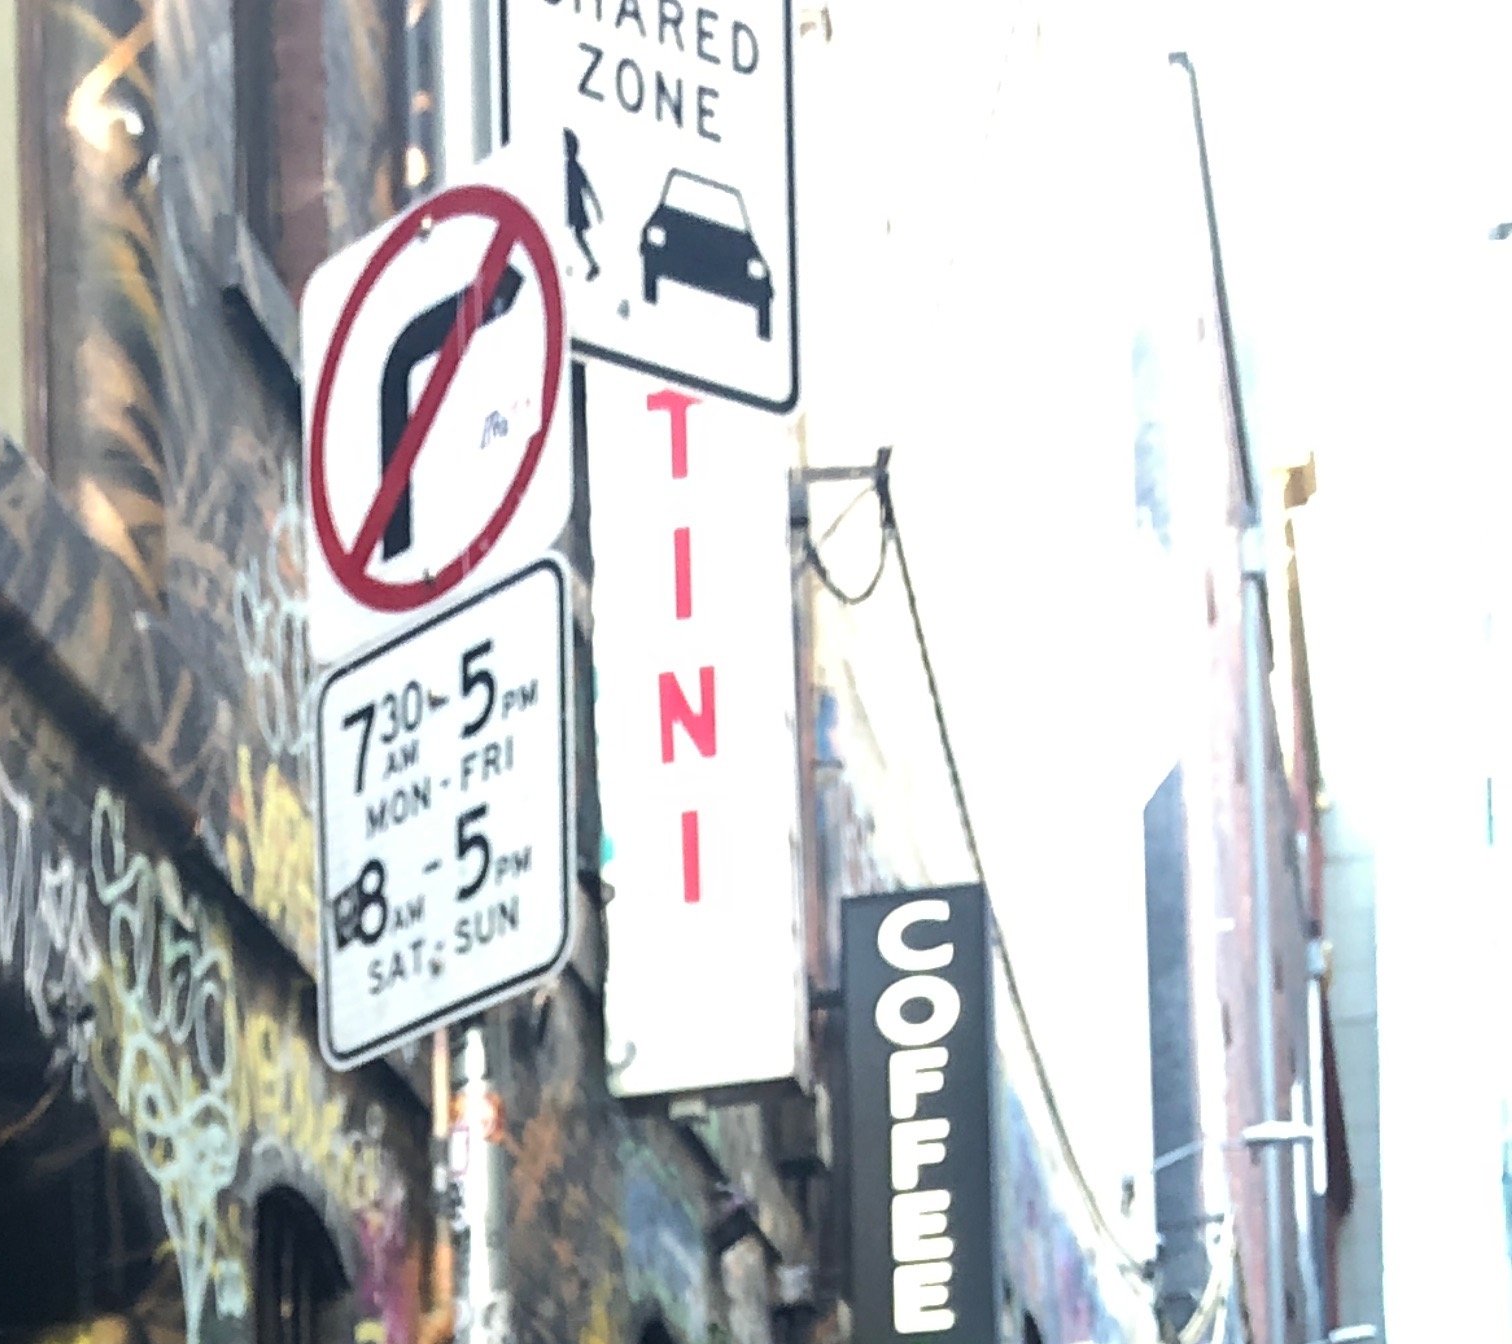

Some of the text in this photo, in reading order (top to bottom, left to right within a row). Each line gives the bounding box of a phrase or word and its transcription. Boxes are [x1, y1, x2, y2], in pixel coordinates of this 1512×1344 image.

[544, 0, 759, 75] ARED
[578, 42, 721, 143] ZONE
[501, 678, 539, 720] PM
[366, 776, 431, 840] MON
[459, 735, 514, 791] FRI
[381, 738, 419, 780] AM
[494, 845, 533, 886] PM
[367, 938, 425, 995] SAT
[454, 895, 519, 954] SUN
[389, 893, 425, 936] AM
[875, 899, 962, 1334] COFFEE
